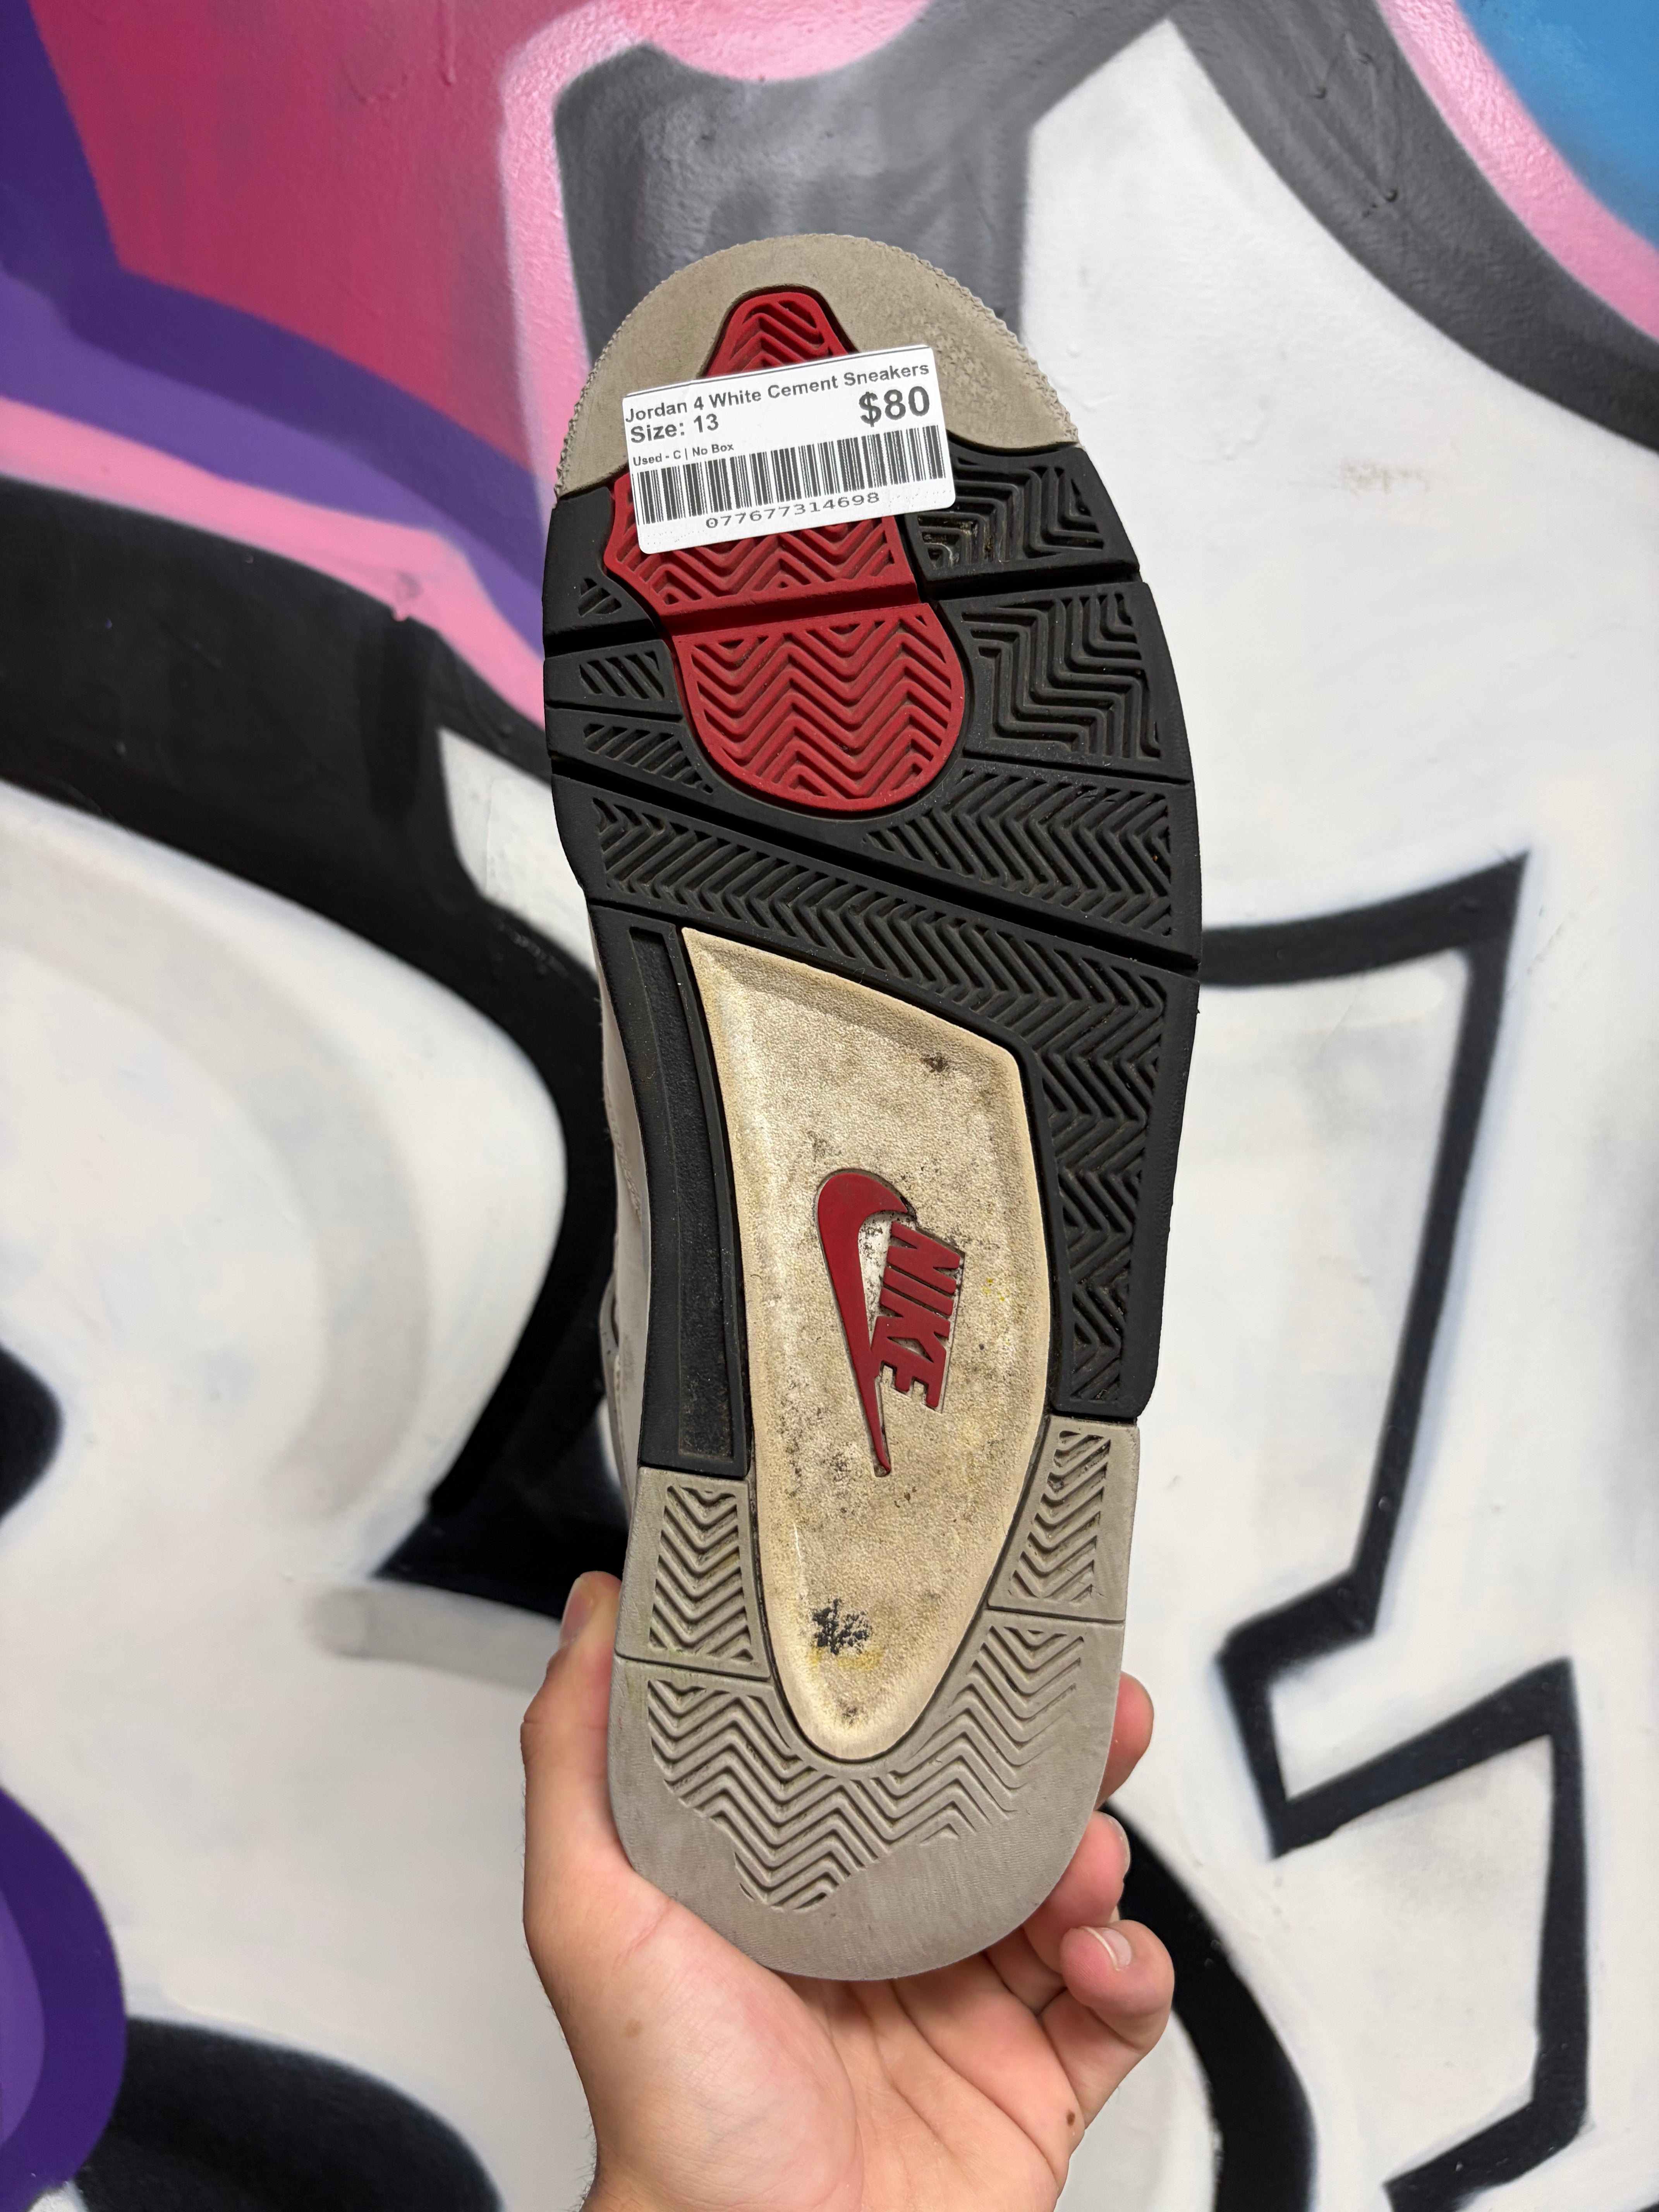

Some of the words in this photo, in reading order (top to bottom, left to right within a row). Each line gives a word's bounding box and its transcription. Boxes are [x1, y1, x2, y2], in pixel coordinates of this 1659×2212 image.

[626, 402, 687, 423] Jordan
[694, 397, 704, 411] 4
[709, 390, 761, 408] White
[768, 376, 838, 398] Cement
[844, 364, 929, 386] Sneakers
[859, 386, 930, 427] $80
[630, 423, 685, 443] Size:
[694, 413, 719, 433] 13
[633, 453, 663, 466] Used
[673, 450, 682, 460] C
[692, 446, 708, 457] No
[711, 443, 734, 454] Box
[706, 492, 880, 528] 077677314698
[870, 1221, 960, 1408] NIKE
